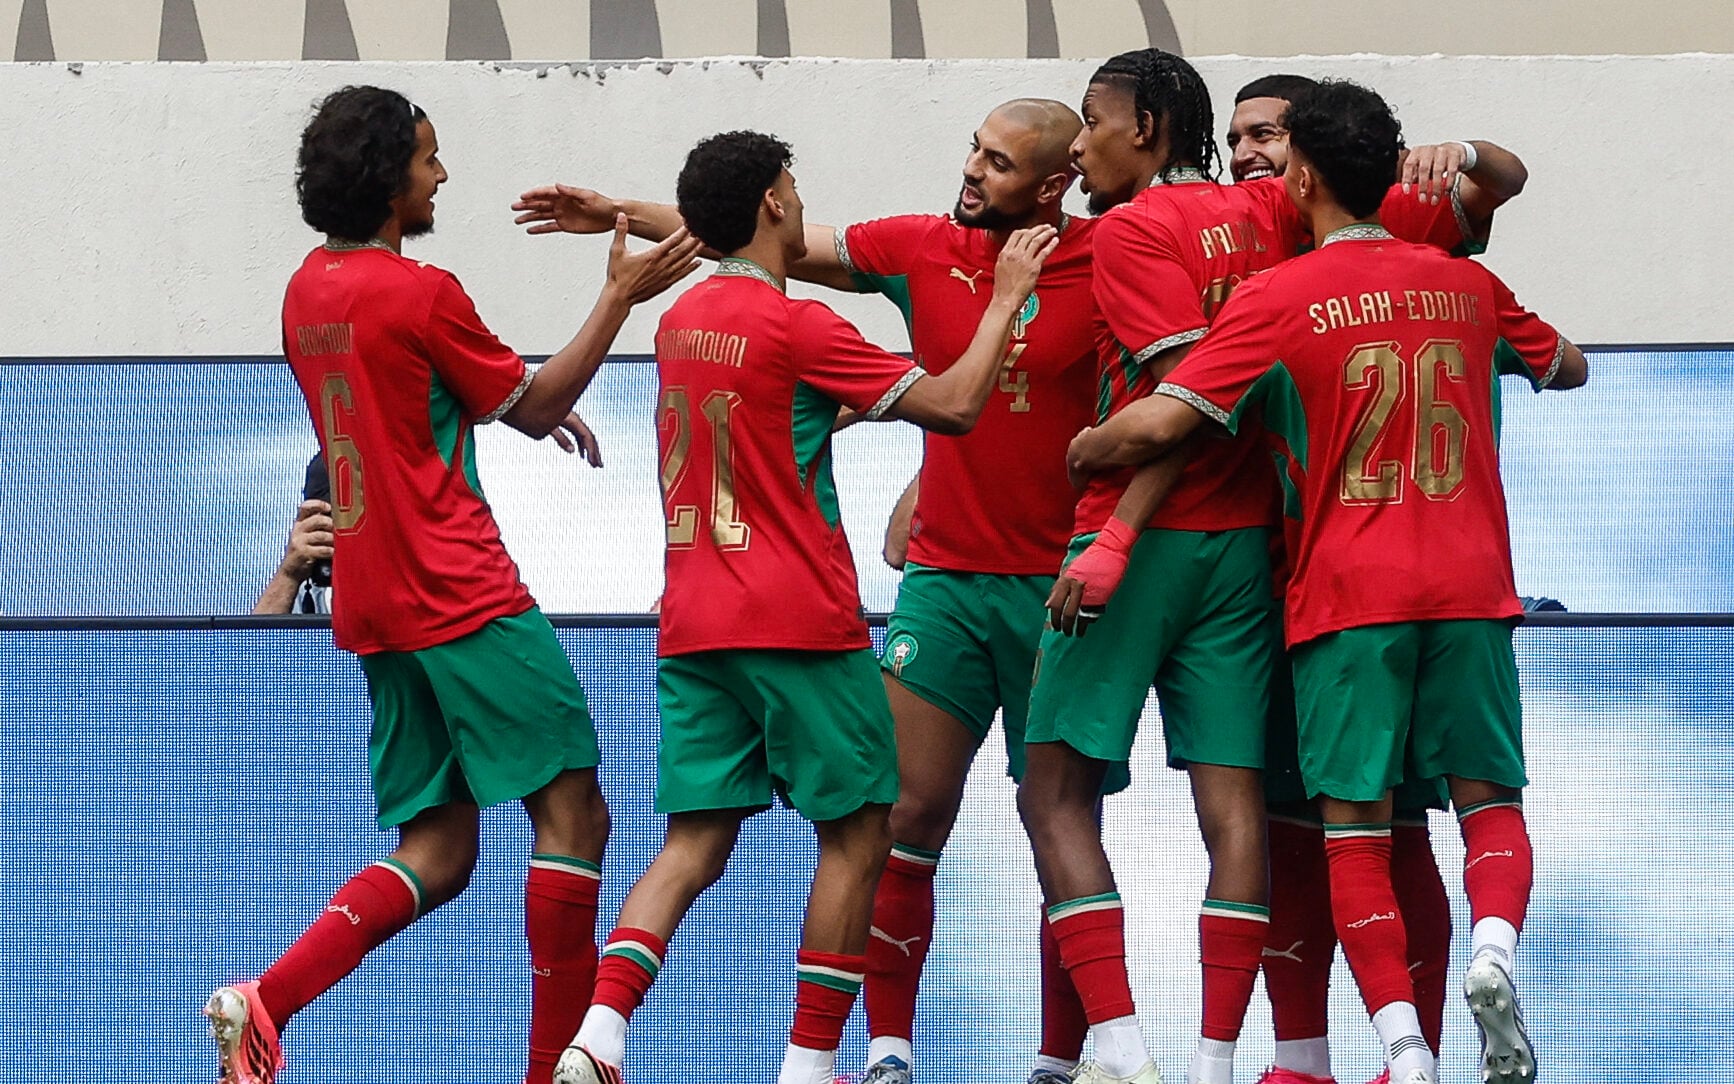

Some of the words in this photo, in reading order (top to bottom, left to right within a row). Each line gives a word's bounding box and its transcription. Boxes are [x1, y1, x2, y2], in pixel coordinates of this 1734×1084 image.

[1199, 223, 1266, 259] HALL
[1309, 290, 1480, 334] SALAH-EDDINE
[999, 343, 1031, 412] 4
[1340, 338, 1469, 506] 26
[319, 372, 366, 536] 6
[657, 385, 750, 552] 21
